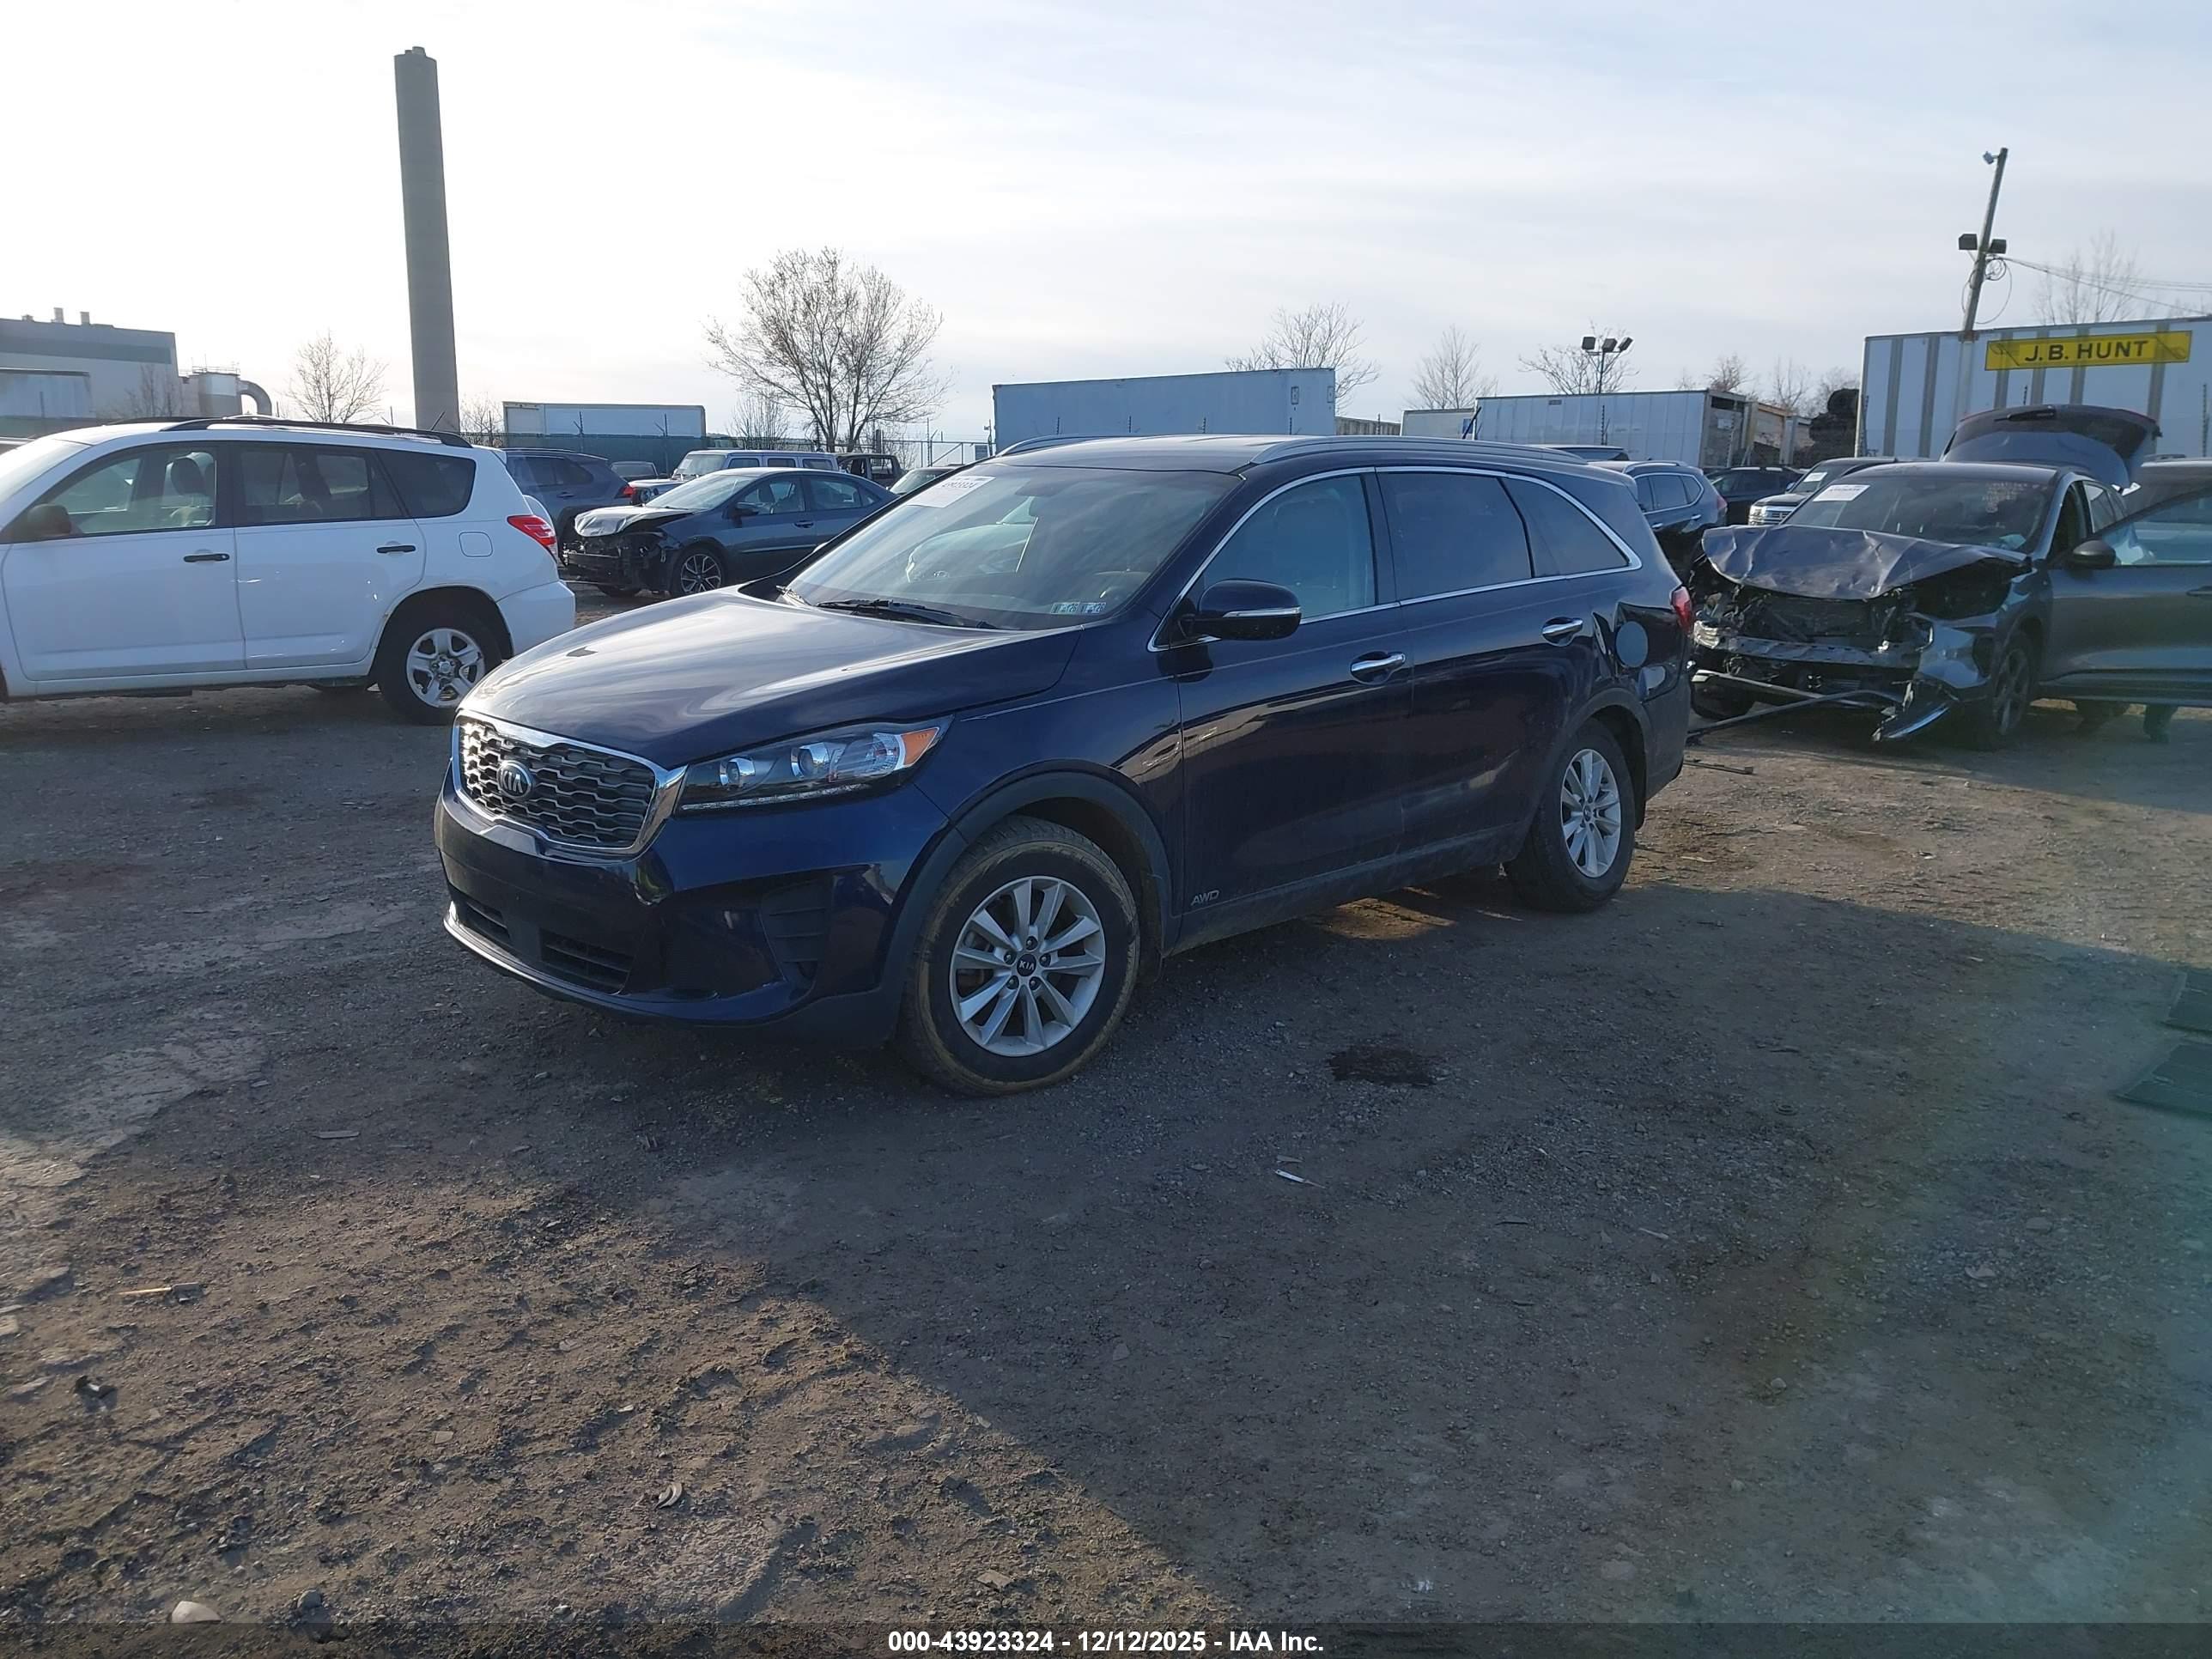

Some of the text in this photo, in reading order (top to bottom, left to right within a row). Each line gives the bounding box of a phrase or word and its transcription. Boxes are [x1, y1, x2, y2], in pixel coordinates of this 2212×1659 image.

[2076, 340, 2148, 360] HUNT
[1190, 890, 1219, 906] AWD
[1019, 960, 1035, 970] KIA
